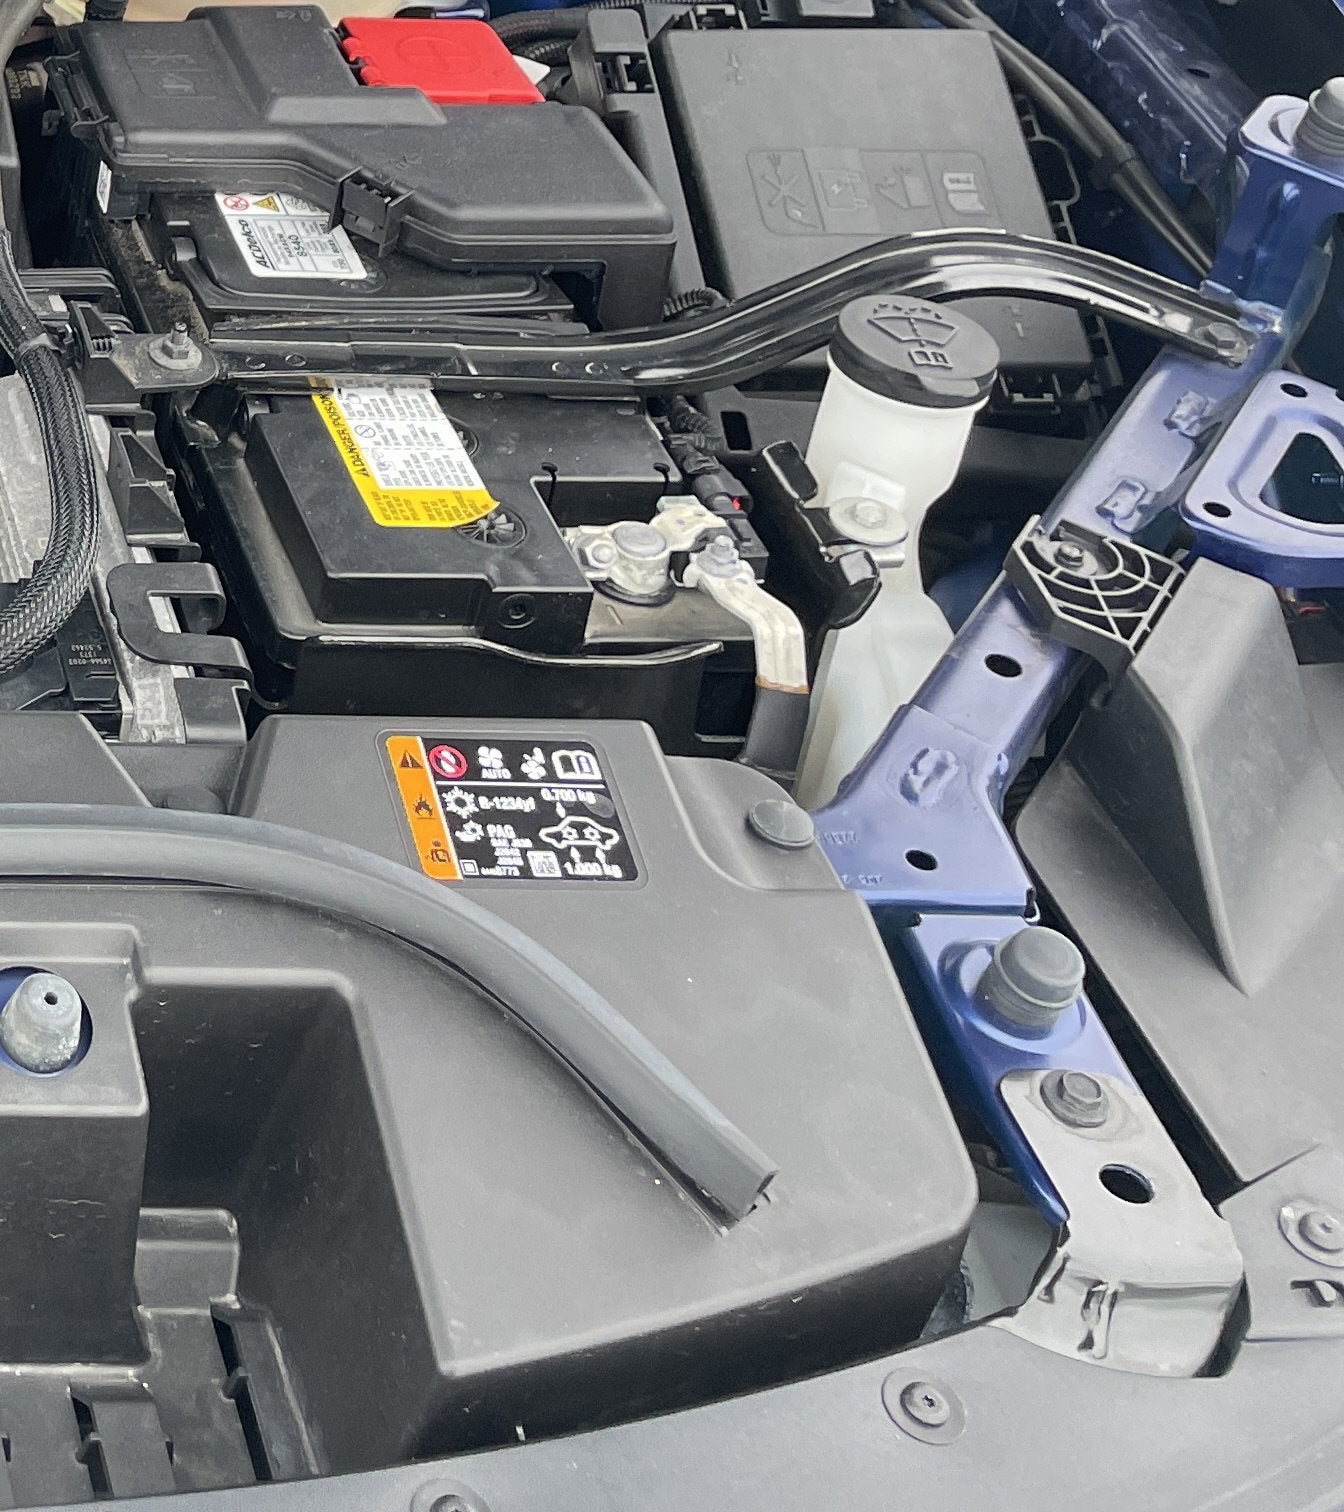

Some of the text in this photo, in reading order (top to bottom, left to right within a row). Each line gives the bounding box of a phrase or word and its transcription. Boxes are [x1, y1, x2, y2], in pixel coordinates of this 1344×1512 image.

[238, 219, 270, 268] ACDelco
[482, 768, 512, 779] AUTO
[540, 788, 596, 804] 0.700 kg
[486, 824, 516, 838] PAG
[563, 861, 622, 878] 1.000 kg
